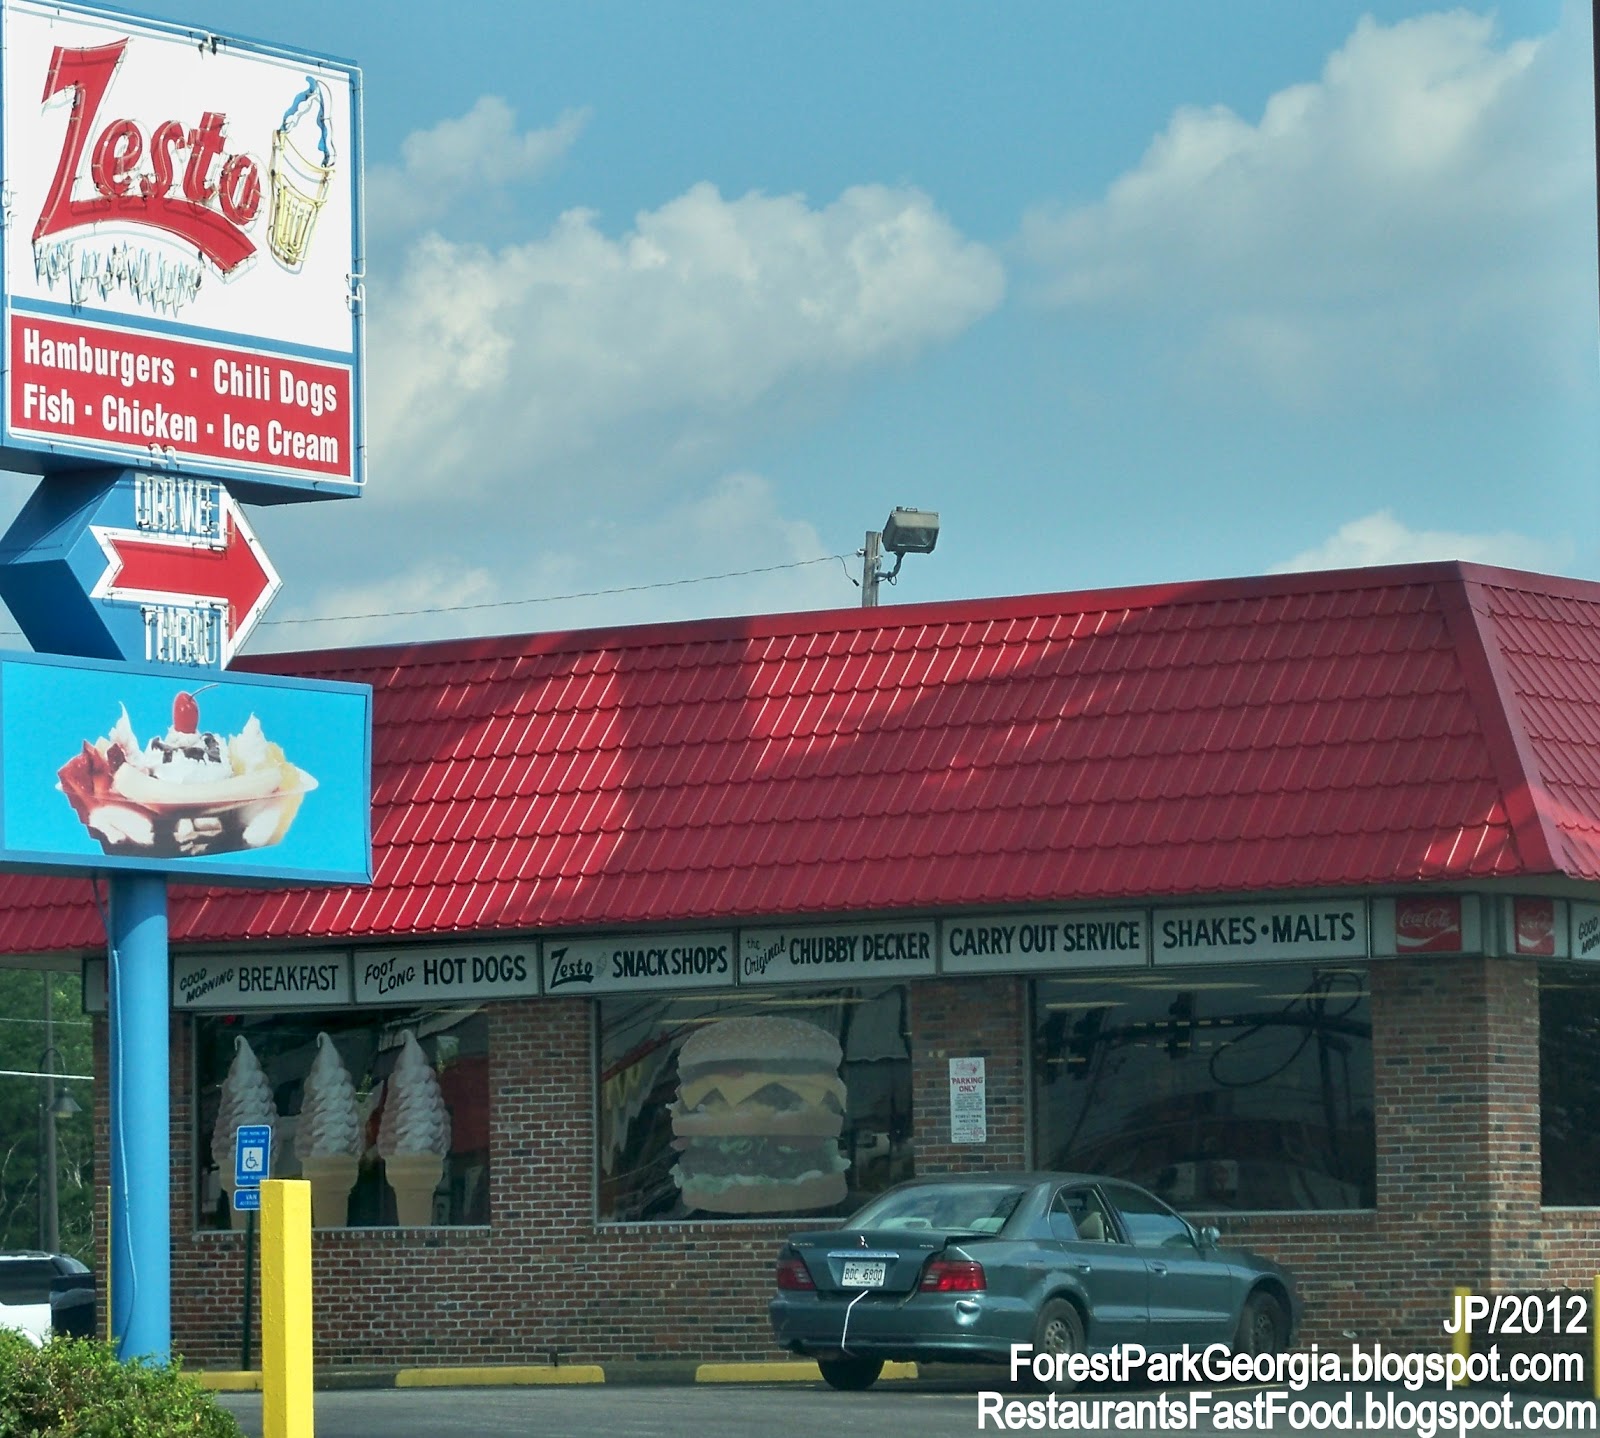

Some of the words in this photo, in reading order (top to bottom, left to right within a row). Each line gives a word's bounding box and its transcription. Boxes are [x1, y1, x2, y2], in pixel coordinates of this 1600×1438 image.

[32, 36, 262, 274] Zesto
[23, 327, 175, 387] Hamburgers
[213, 358, 271, 401] Chili
[279, 369, 338, 417] Dogs
[23, 383, 75, 425] Fish
[102, 394, 198, 443] Chicken
[223, 413, 260, 452] Ice
[267, 419, 339, 464] Cream
[134, 472, 213, 534] DRIVE
[141, 604, 217, 664] THRU
[744, 935, 787, 976] Original
[789, 935, 859, 966] CHUBBY
[862, 931, 930, 962] DECKER
[949, 926, 1016, 956] CARRY
[1018, 924, 1058, 953] OUT
[1063, 920, 1140, 953] SERVICE
[180, 967, 207, 991] GOOD
[238, 965, 339, 993] BREAKFAST
[364, 958, 396, 985] FOOT
[423, 957, 467, 986] HOT
[472, 955, 527, 983] DOGS
[549, 947, 594, 989] Zesto
[612, 948, 671, 978] SNACK
[671, 945, 728, 975] SHOPS
[186, 968, 235, 1003] MORNING
[378, 966, 416, 995] LONG
